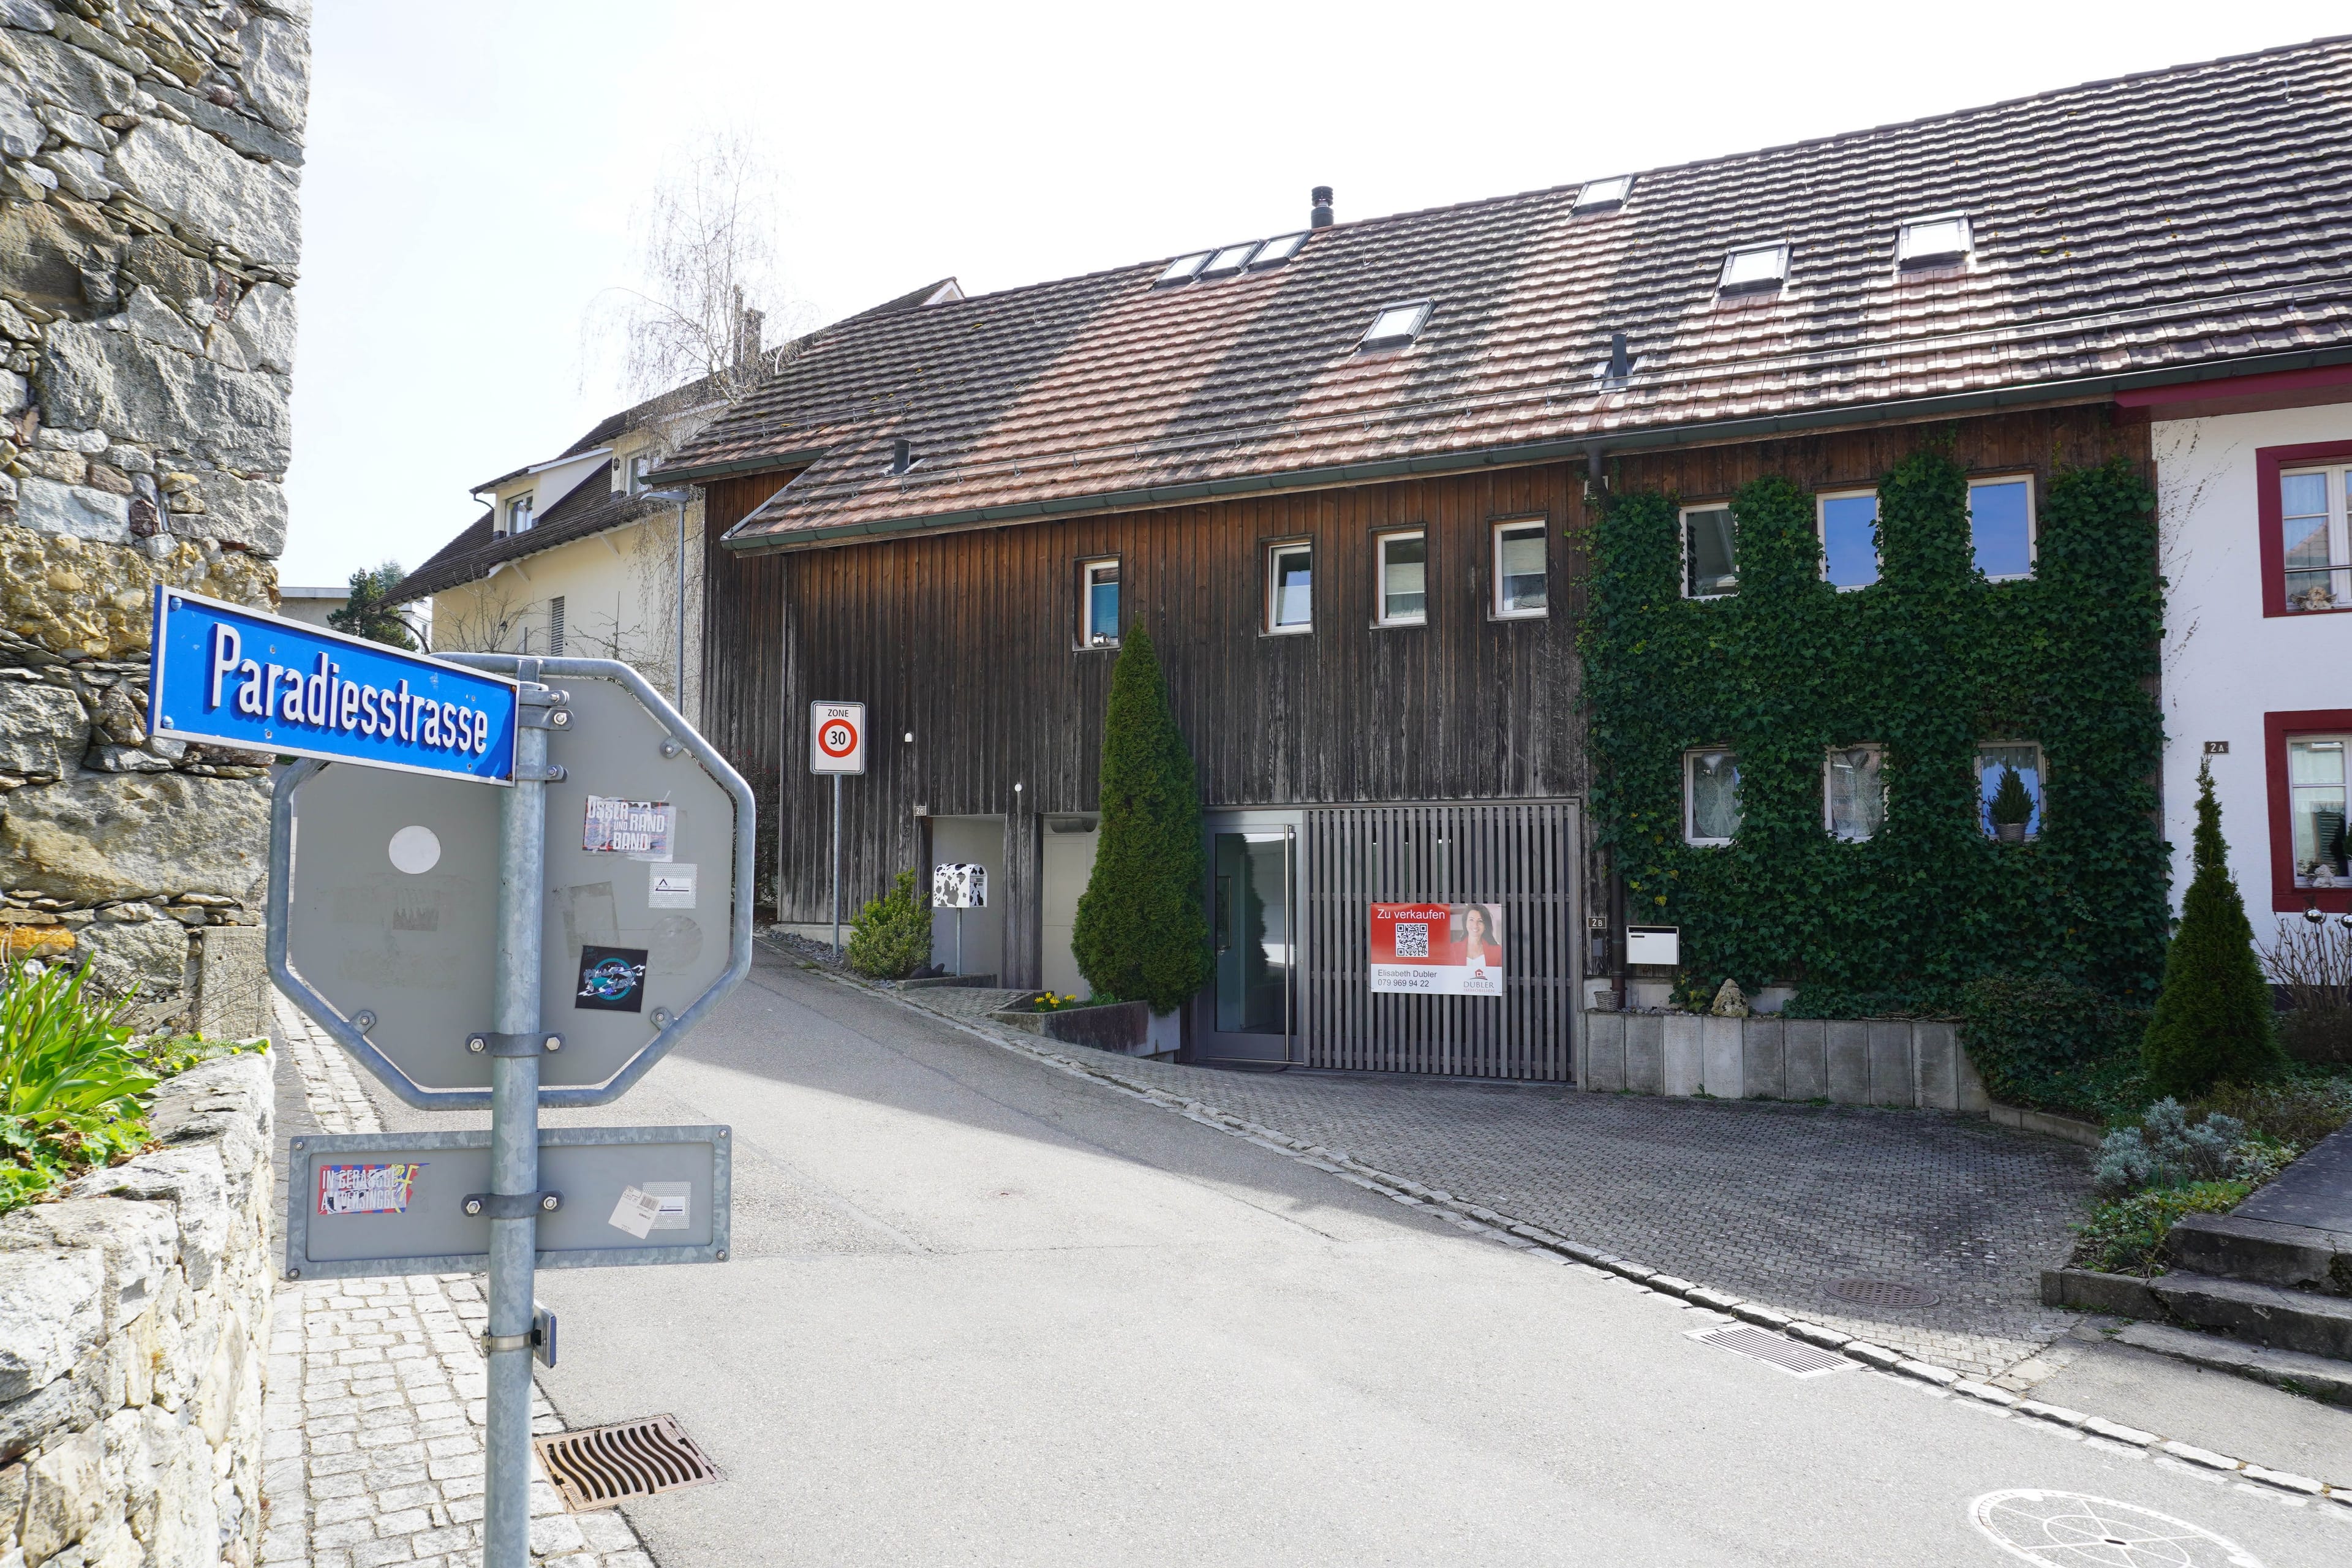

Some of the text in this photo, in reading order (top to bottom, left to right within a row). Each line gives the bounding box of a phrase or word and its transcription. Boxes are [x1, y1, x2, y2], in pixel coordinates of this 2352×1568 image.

[211, 622, 489, 754] Paradiesstrasse
[827, 709, 849, 717] ZONE
[831, 731, 846, 745] 30
[614, 813, 665, 832] UND RAND
[613, 832, 649, 850] BAND
[1378, 909, 1445, 919] Zu verkaufen
[322, 1170, 334, 1189] IN
